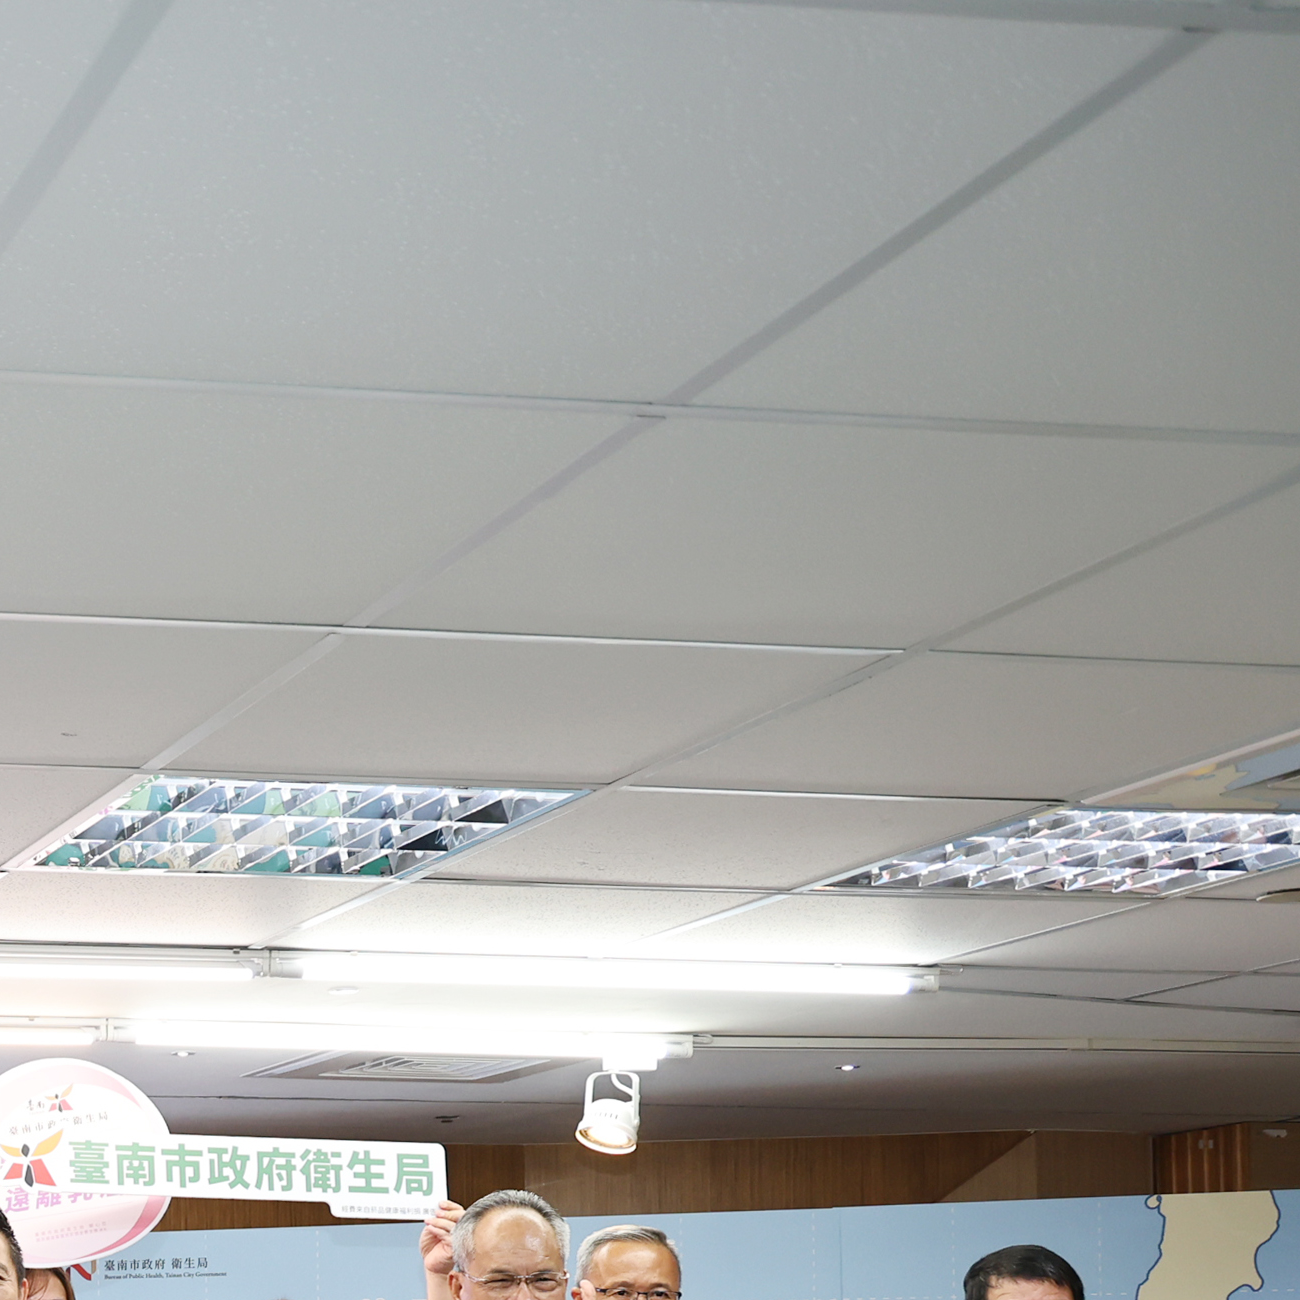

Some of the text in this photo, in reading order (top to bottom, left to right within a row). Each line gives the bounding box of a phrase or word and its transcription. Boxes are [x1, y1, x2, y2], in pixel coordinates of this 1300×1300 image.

[67, 1139, 435, 1197] 臺南市政府衛生局
[104, 1256, 209, 1272] 臺南市政府 衛生局
[183, 1271, 194, 1279] City
